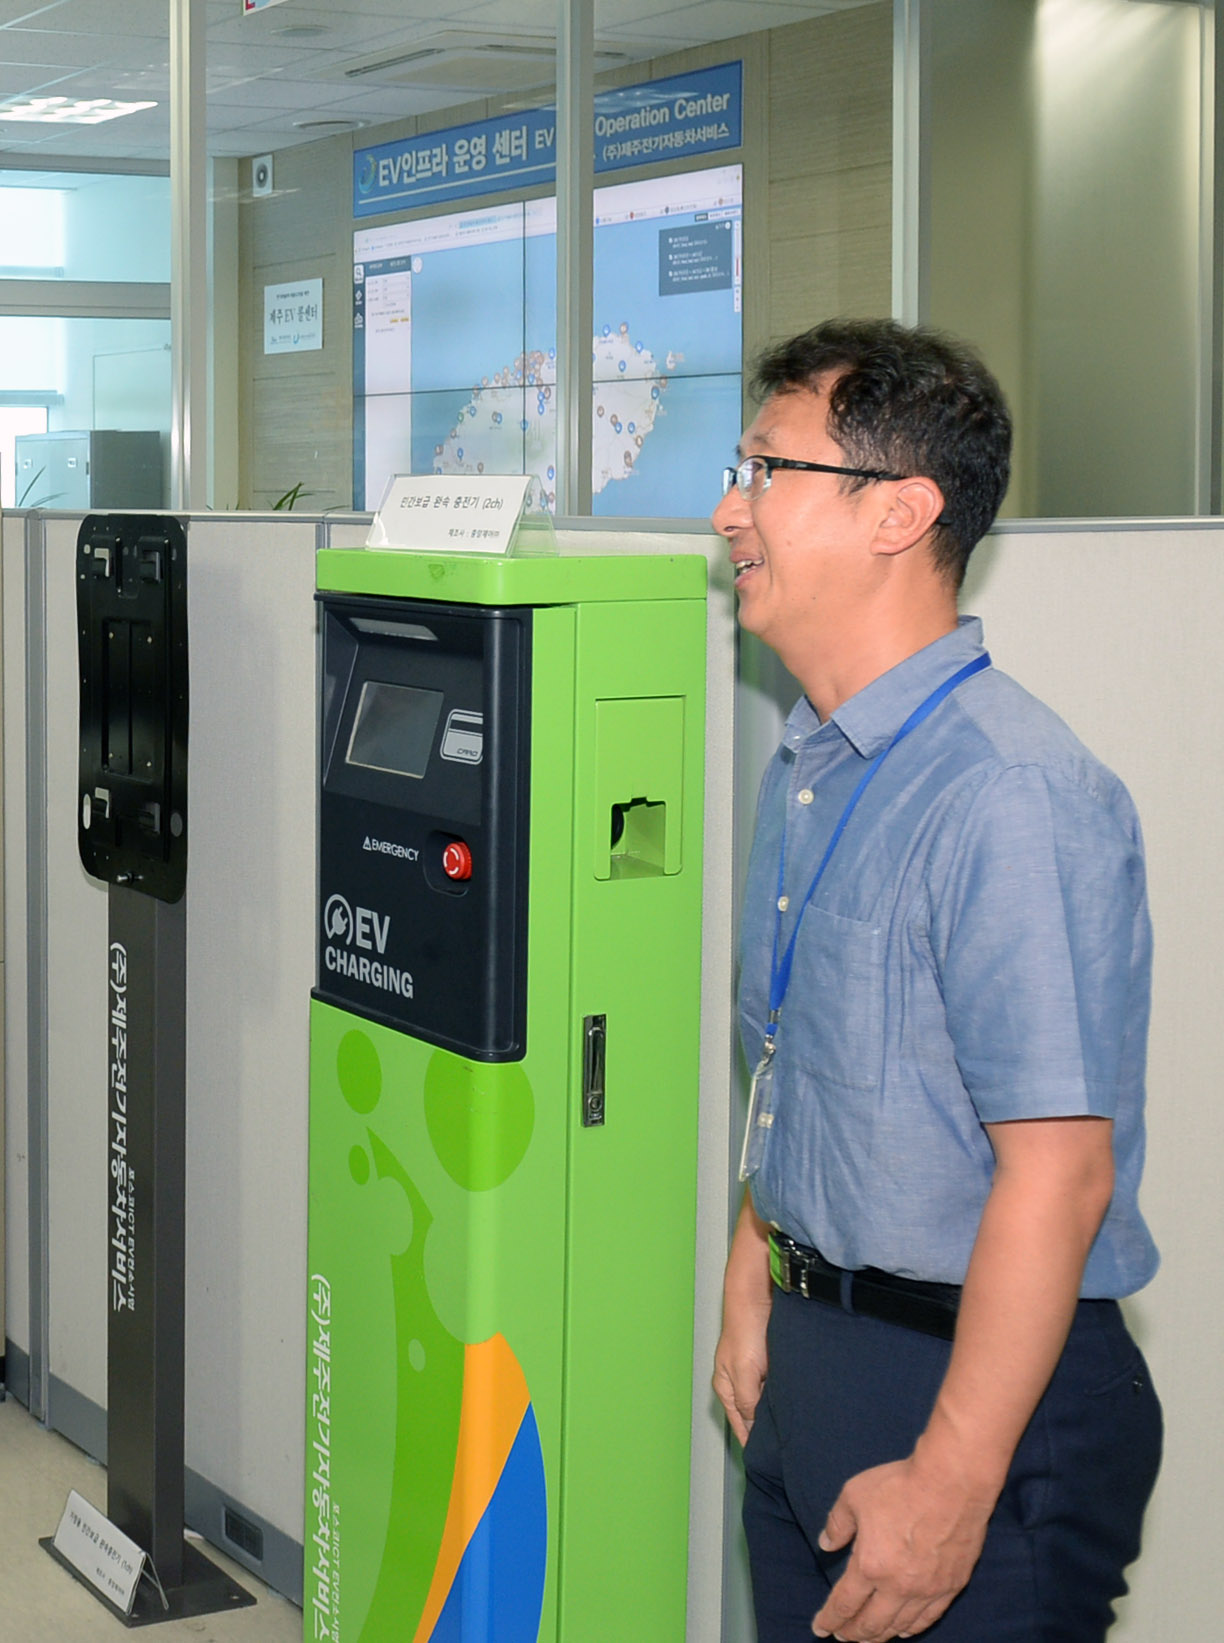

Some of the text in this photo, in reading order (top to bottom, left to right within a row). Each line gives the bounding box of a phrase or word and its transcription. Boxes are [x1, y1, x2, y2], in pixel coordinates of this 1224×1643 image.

[379, 93, 730, 187] EV인프라 운영 센터 EV Operation Center
[603, 122, 730, 162] (주)제주전기자동차서비스
[433, 496, 451, 509] 완속
[453, 496, 479, 509] 충전기
[482, 498, 503, 510] (2ch)
[371, 838, 419, 861] EMERGENCY
[356, 906, 390, 954] EV
[326, 946, 414, 999] CHARGING
[111, 942, 127, 1312] (주)제주전기자동차서비스
[311, 1273, 331, 1641] (주)제주전기자동차서비스
